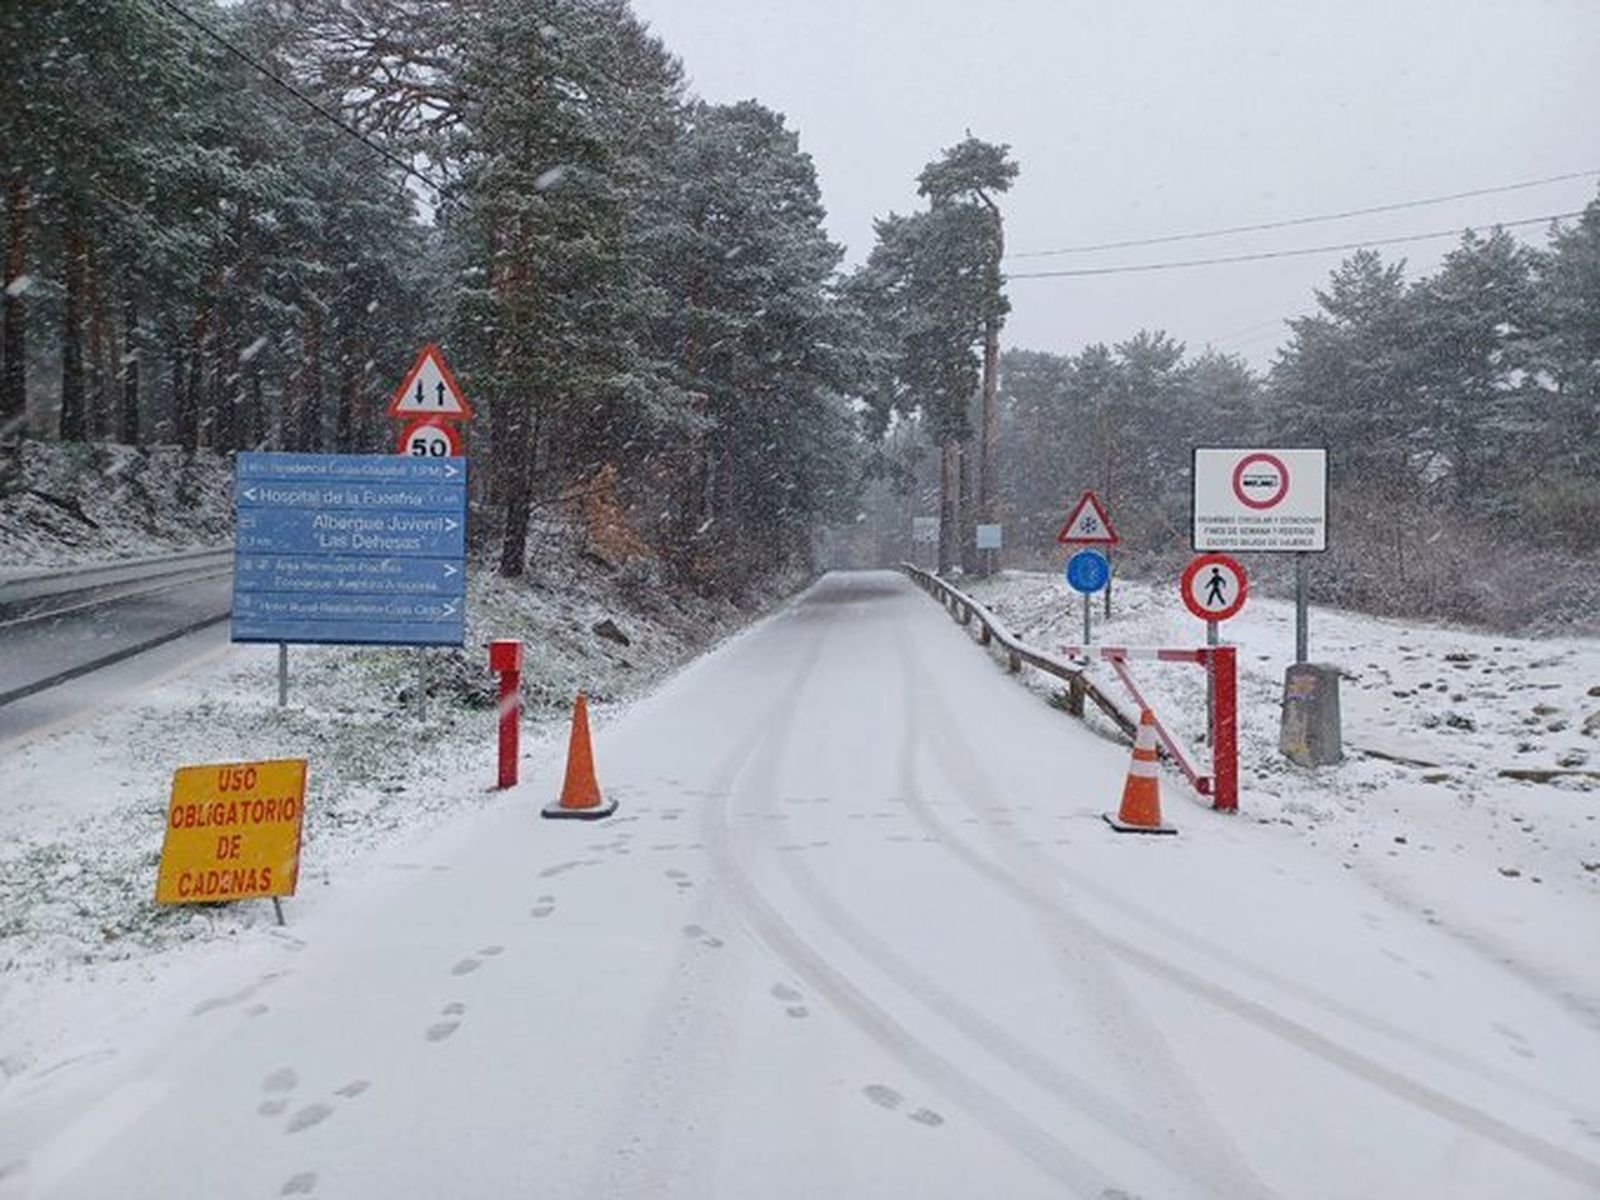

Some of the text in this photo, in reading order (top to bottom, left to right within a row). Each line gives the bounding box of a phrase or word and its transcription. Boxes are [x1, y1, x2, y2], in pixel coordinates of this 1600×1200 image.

[412, 438, 447, 457] 50
[259, 488, 320, 505] Hospital
[323, 489, 343, 504] de
[347, 491, 359, 504] la
[312, 514, 443, 532] Albergue Juvenil
[218, 768, 257, 792] USO
[171, 797, 296, 829] OBLIGATORIO
[216, 834, 242, 860] DE
[177, 867, 272, 898] CADENAS
